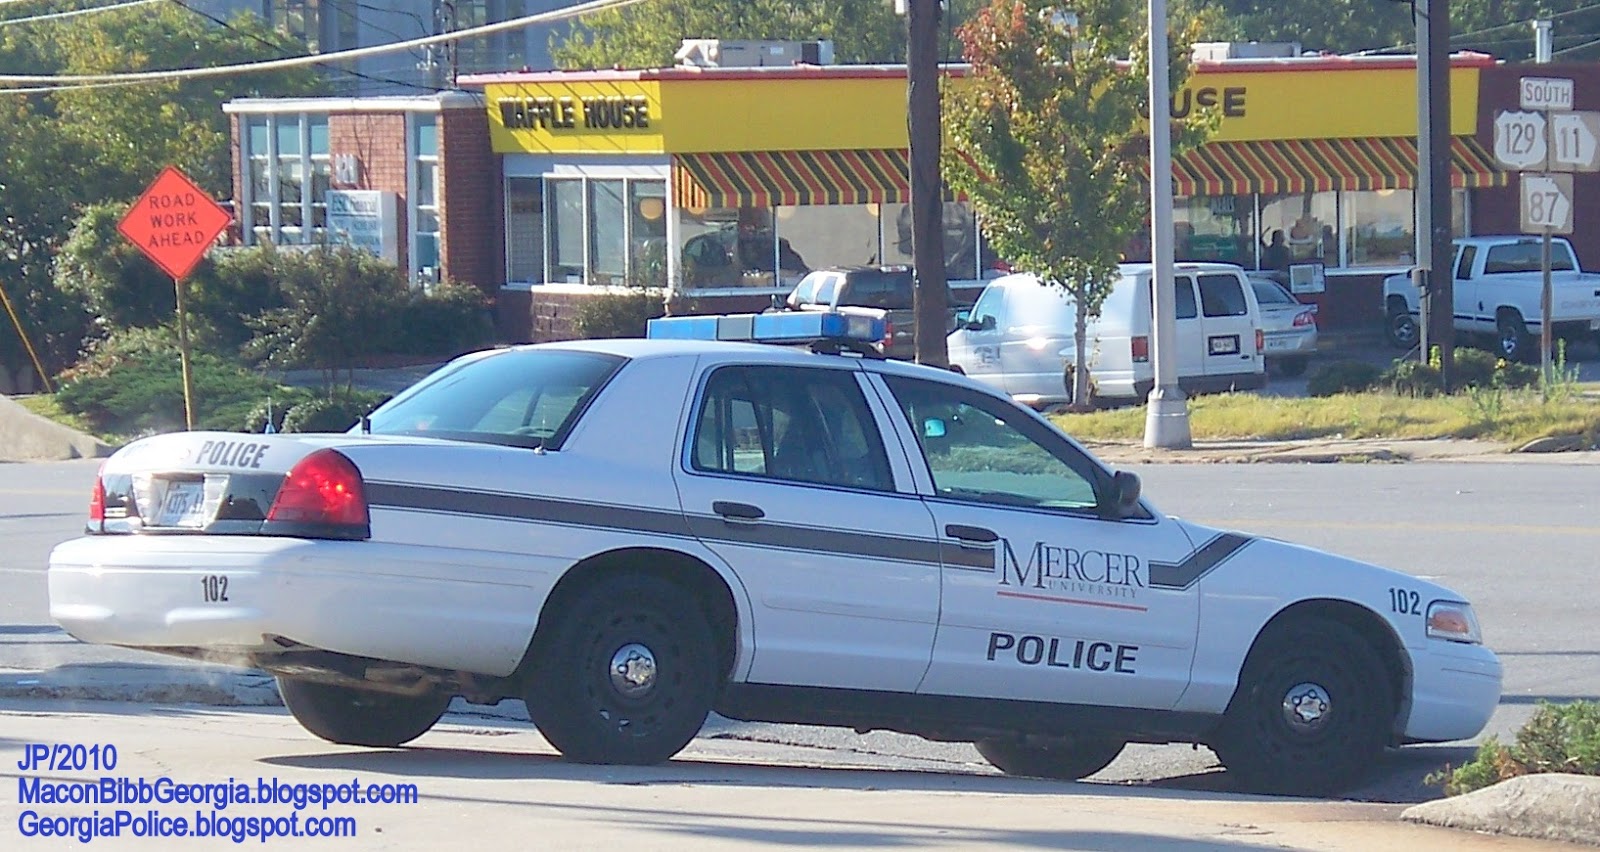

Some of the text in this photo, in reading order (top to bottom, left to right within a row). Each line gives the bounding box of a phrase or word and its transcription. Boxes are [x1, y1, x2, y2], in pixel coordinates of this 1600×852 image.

[1525, 83, 1569, 103] SOUTH
[499, 95, 649, 130] WAFFLE HOUSE
[1504, 123, 1535, 154] 129
[1561, 127, 1580, 159] 11
[150, 193, 196, 210] ROAD
[1530, 191, 1560, 223] 87
[151, 212, 198, 229] WORK
[149, 231, 205, 248] AHEAD
[195, 440, 270, 468] POLICE
[998, 537, 1145, 589] MERCER
[201, 574, 229, 602] 102
[1049, 580, 1137, 599] UNIVERSITY
[1389, 587, 1422, 616] 102
[986, 632, 1139, 675] POLICE
